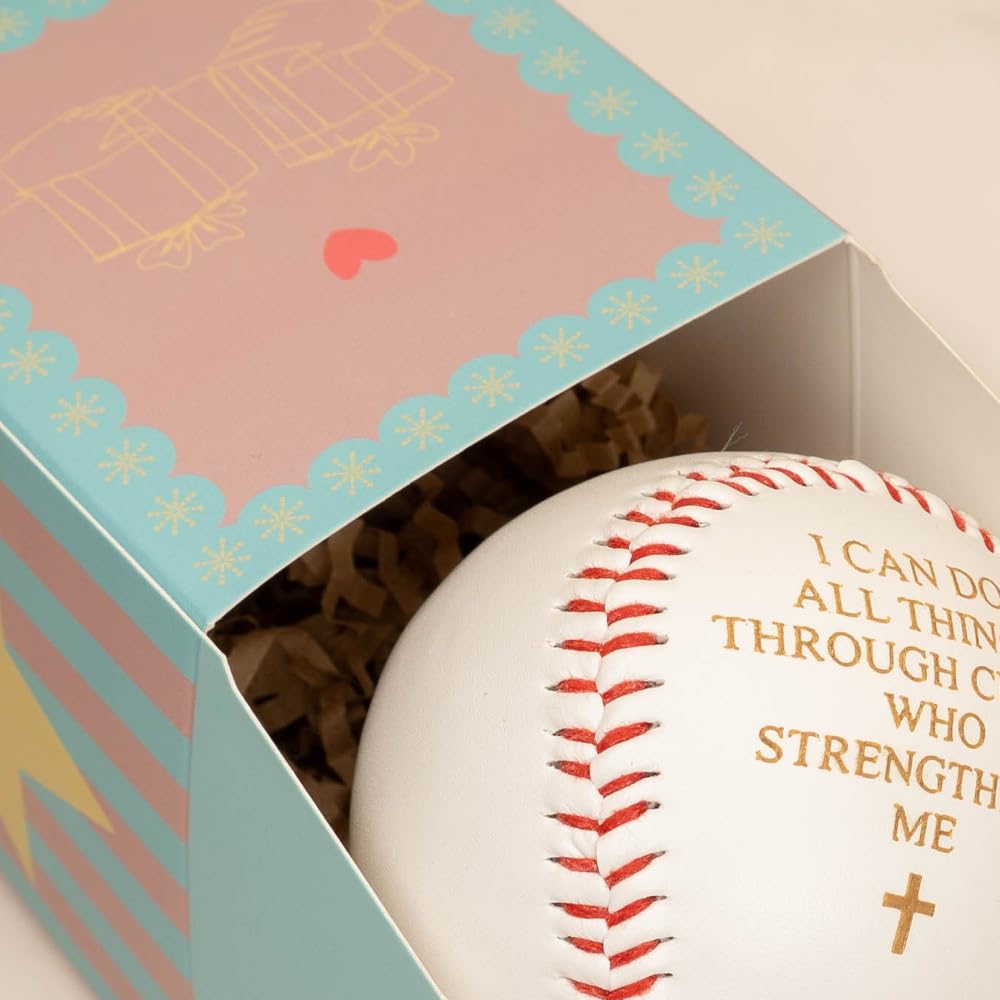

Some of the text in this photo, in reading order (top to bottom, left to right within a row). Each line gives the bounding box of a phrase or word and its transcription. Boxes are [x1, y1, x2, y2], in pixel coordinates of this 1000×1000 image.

[808, 533, 831, 566] I
[842, 540, 939, 589] CAN
[794, 578, 891, 624] ALL
[711, 614, 958, 690] THROUGH
[884, 691, 986, 749] WHO
[892, 803, 957, 854] ME
